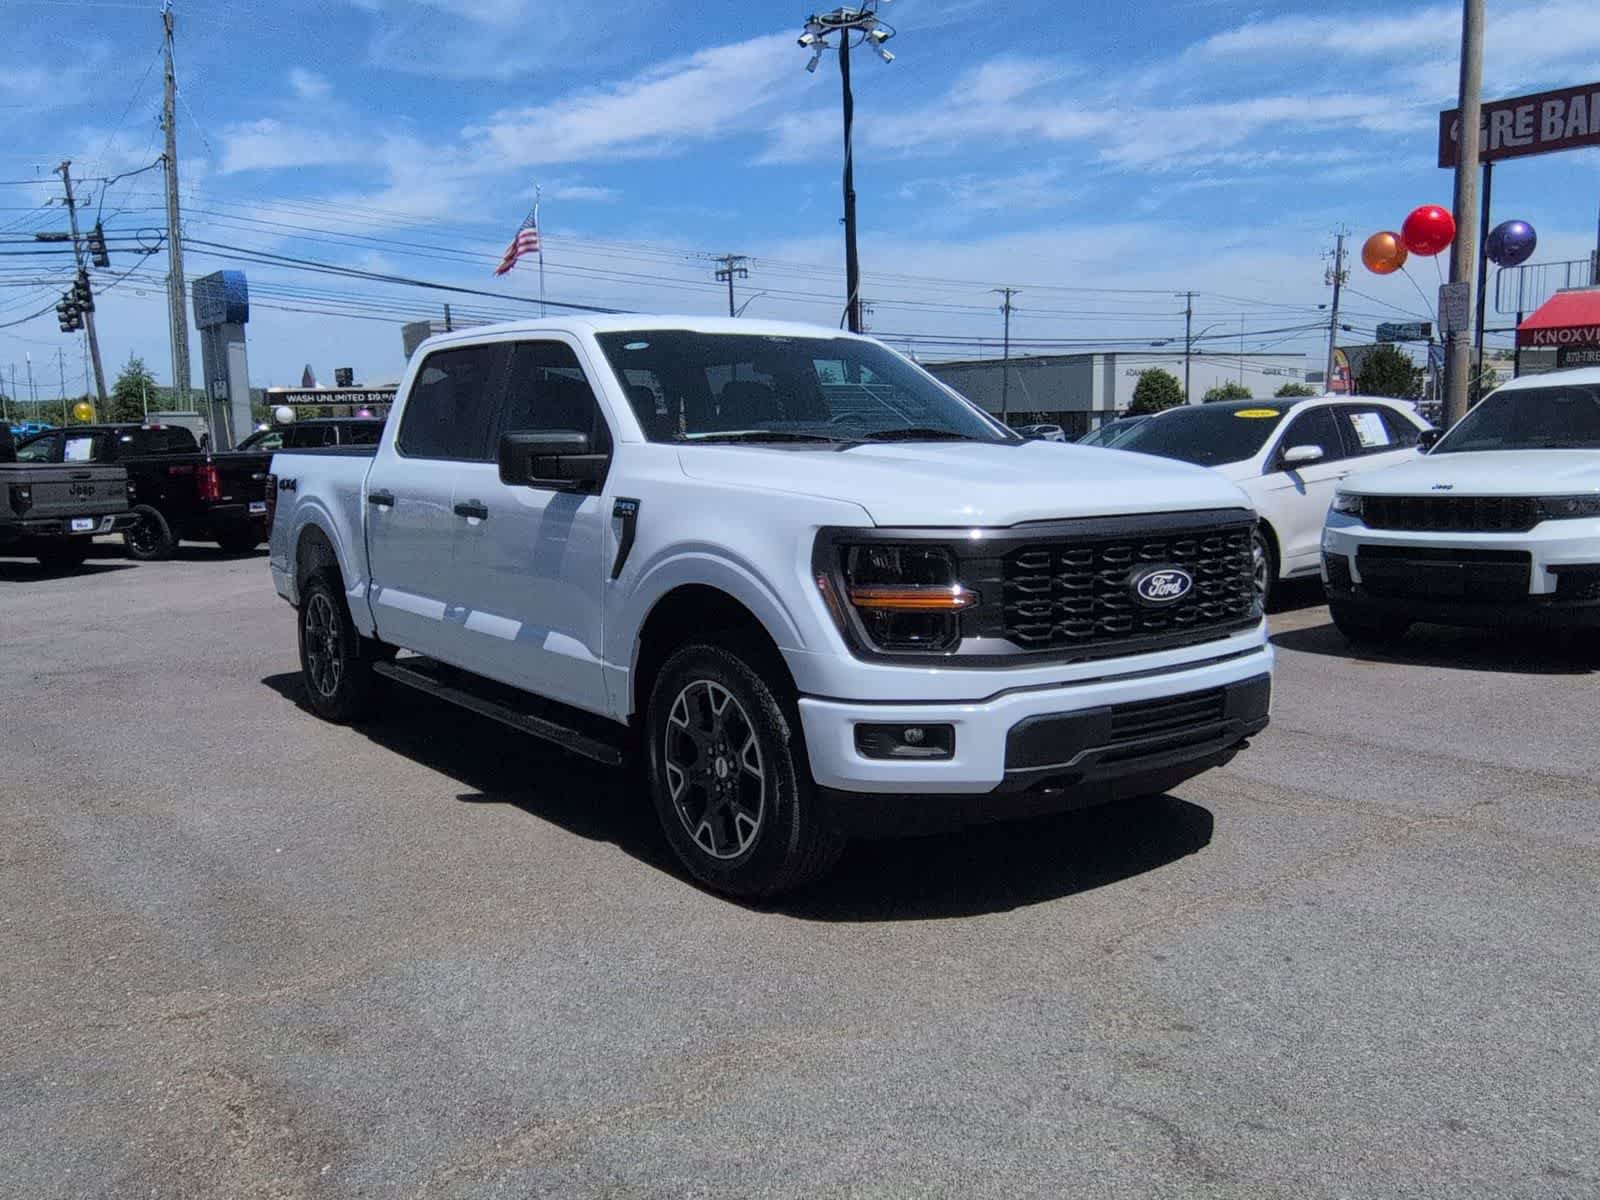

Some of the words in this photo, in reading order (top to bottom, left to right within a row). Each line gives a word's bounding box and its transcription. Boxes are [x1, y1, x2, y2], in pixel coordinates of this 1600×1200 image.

[1450, 104, 1534, 153] IRE
[286, 394, 314, 402] WASH
[316, 393, 365, 402] UNLIMITED
[69, 483, 96, 496] Jeep
[1147, 573, 1183, 597] Ford
